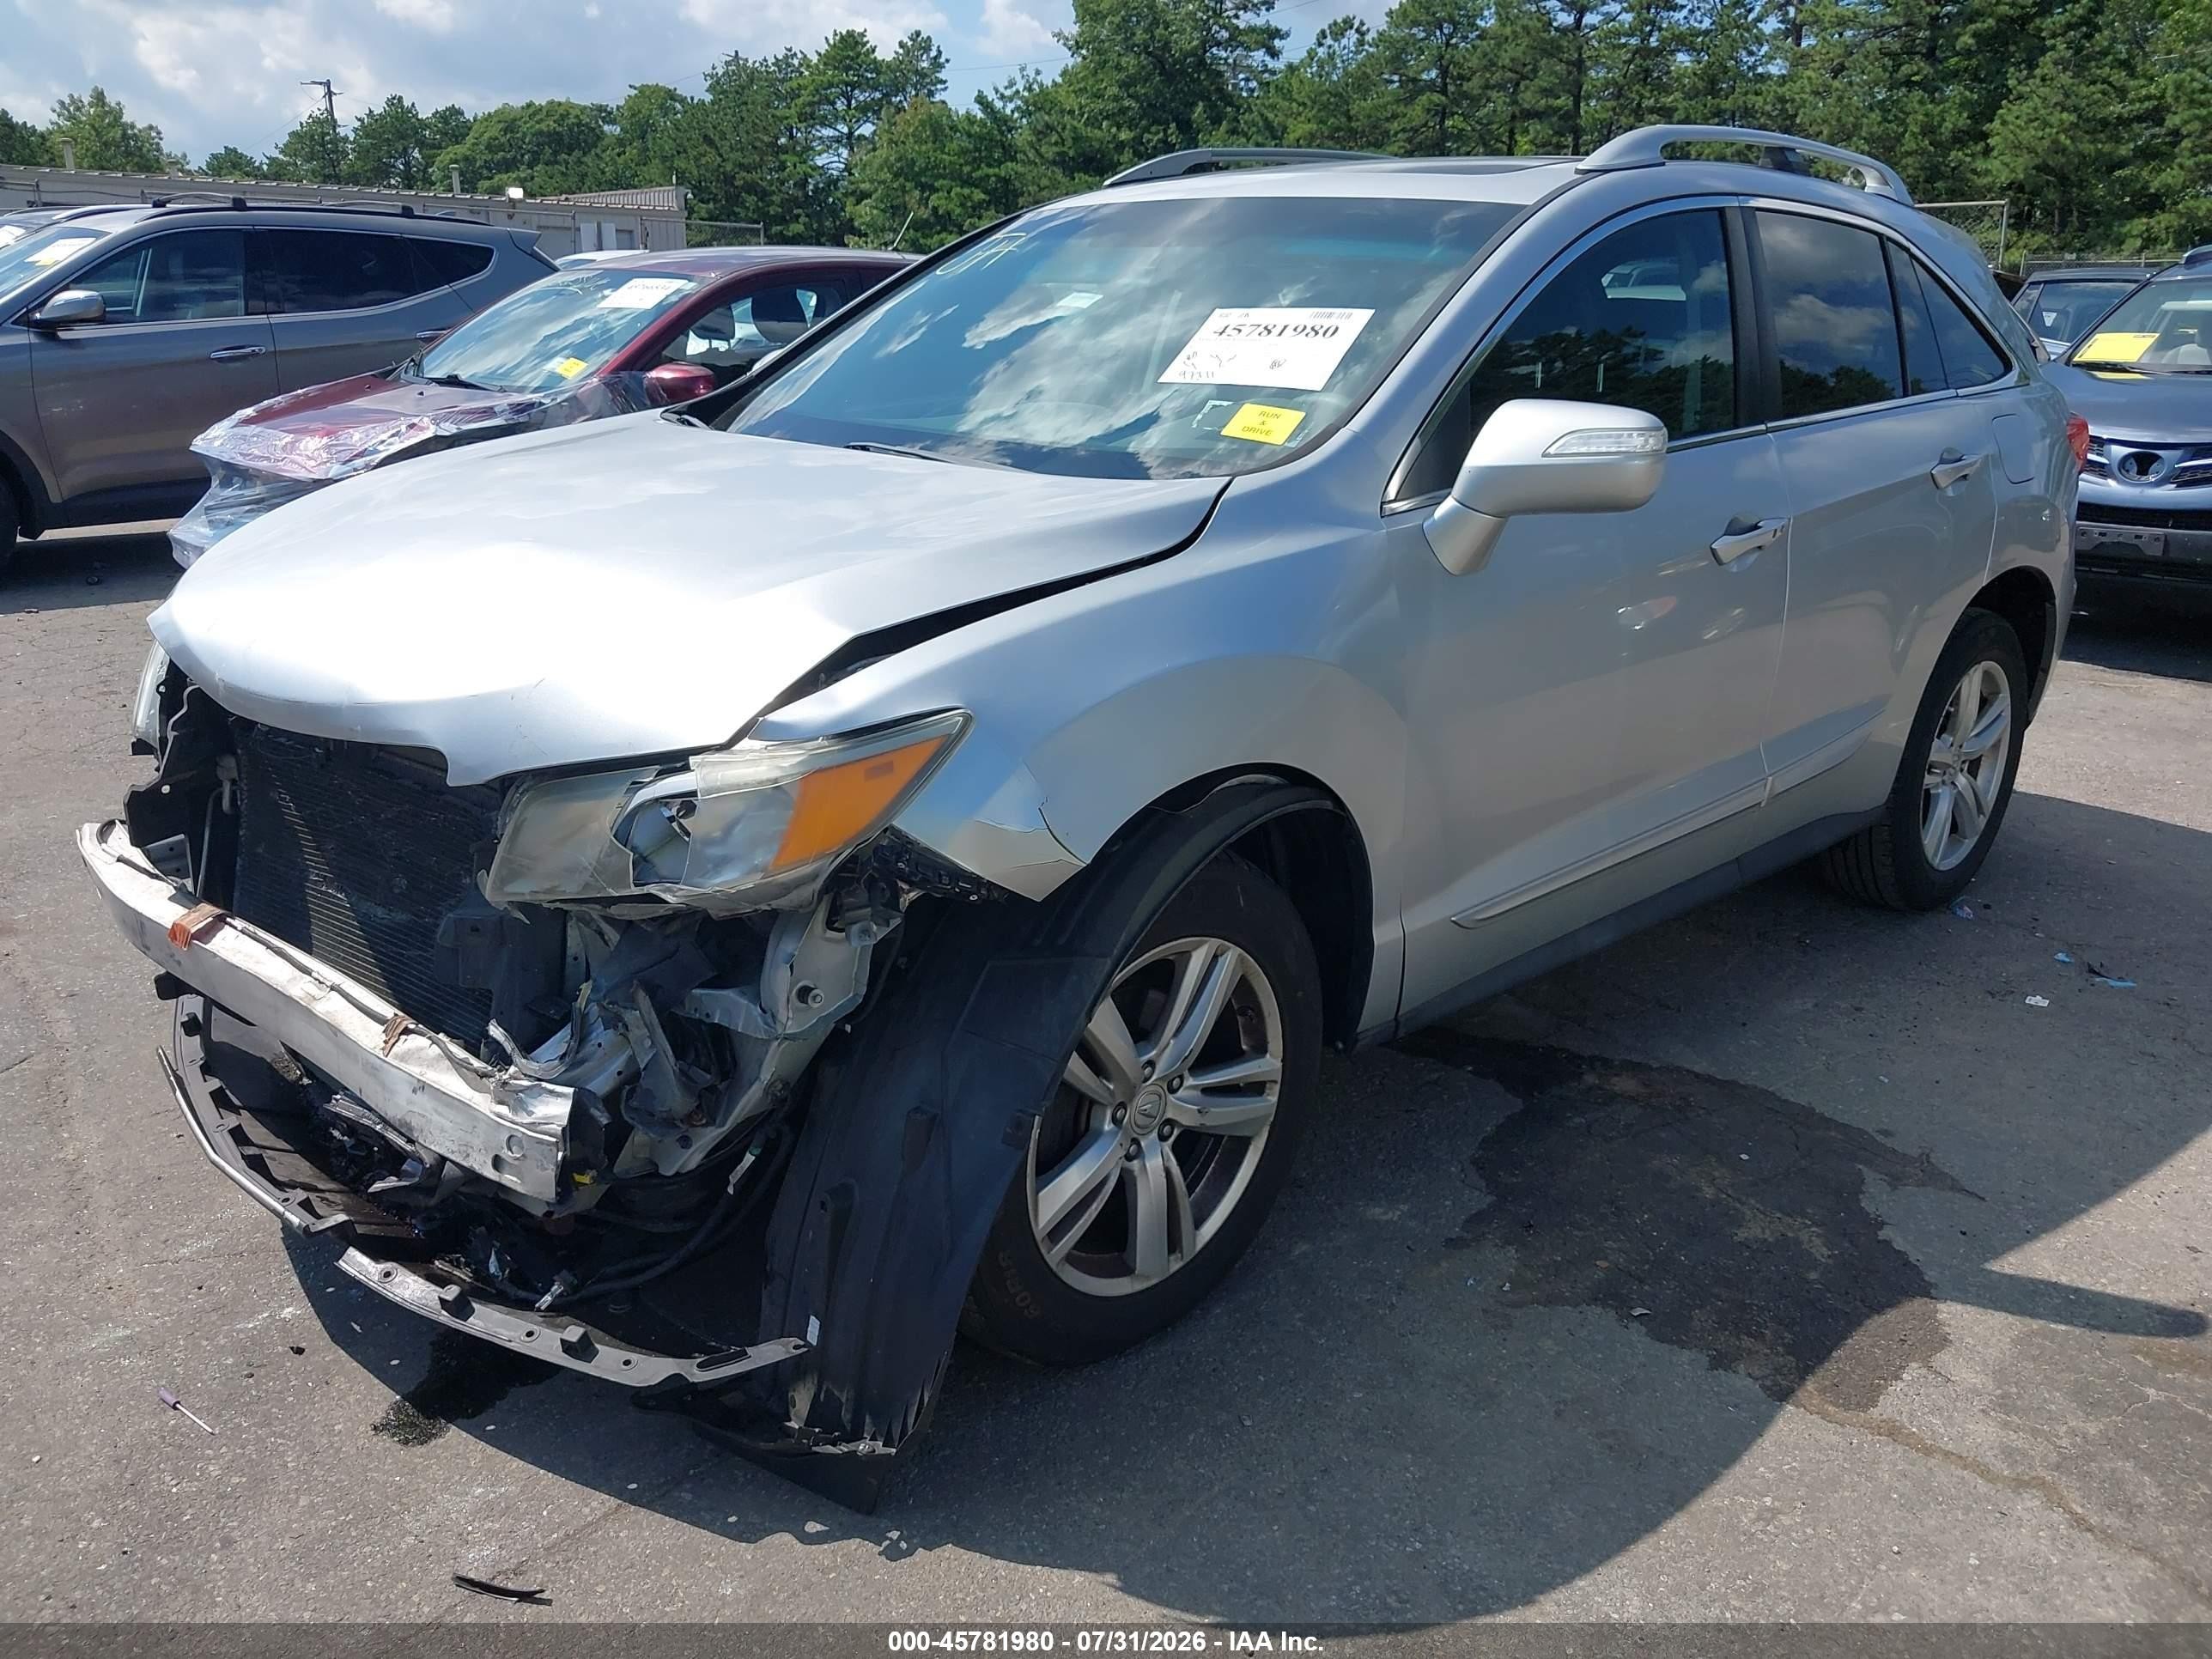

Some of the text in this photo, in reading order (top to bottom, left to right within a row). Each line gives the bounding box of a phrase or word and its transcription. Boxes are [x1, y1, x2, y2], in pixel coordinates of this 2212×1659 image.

[1212, 323, 1340, 338] 45781980
[1258, 410, 1282, 420] RUN
[1242, 426, 1273, 436] DRIVE
